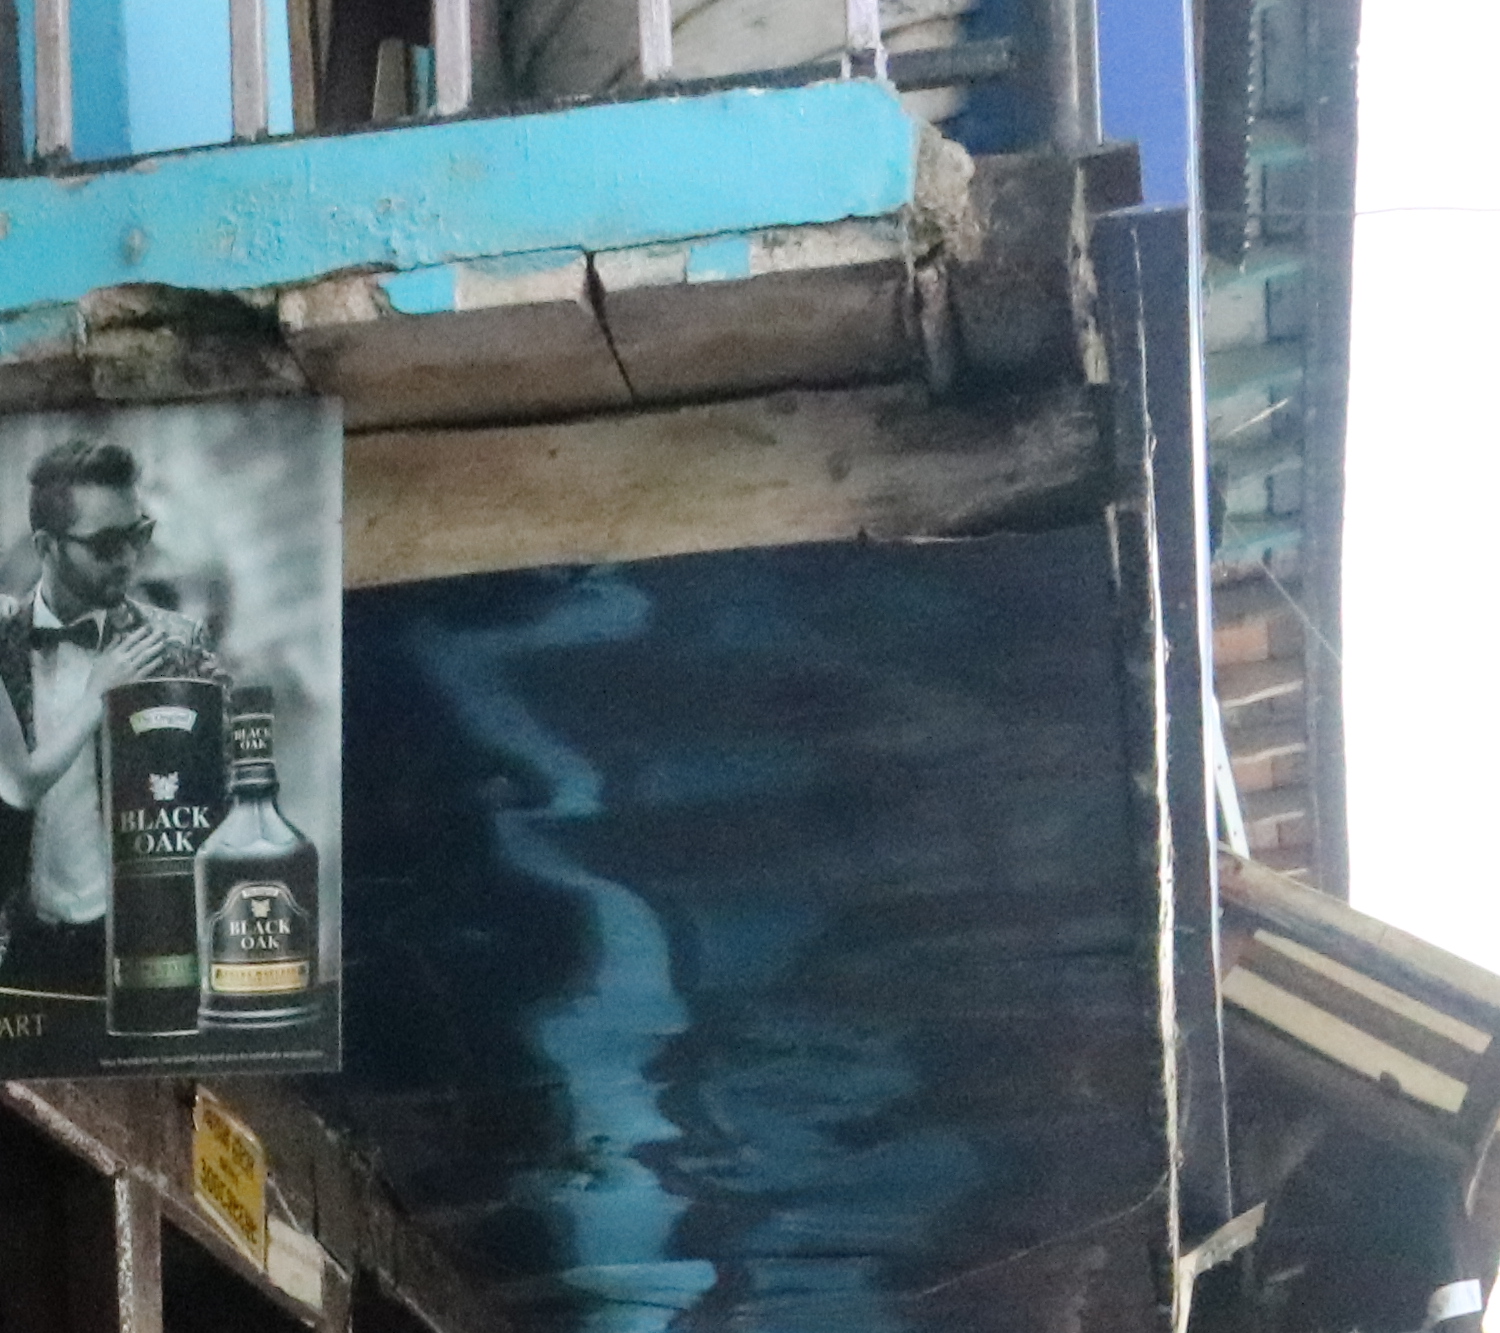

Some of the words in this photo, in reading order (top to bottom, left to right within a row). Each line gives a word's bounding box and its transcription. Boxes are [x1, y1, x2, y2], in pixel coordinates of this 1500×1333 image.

[234, 727, 273, 741] BLACK
[240, 738, 267, 750] OAK
[120, 805, 211, 831] BLACK
[134, 831, 196, 854] OAK
[229, 918, 291, 936] BLACK
[241, 934, 280, 950] OAK
